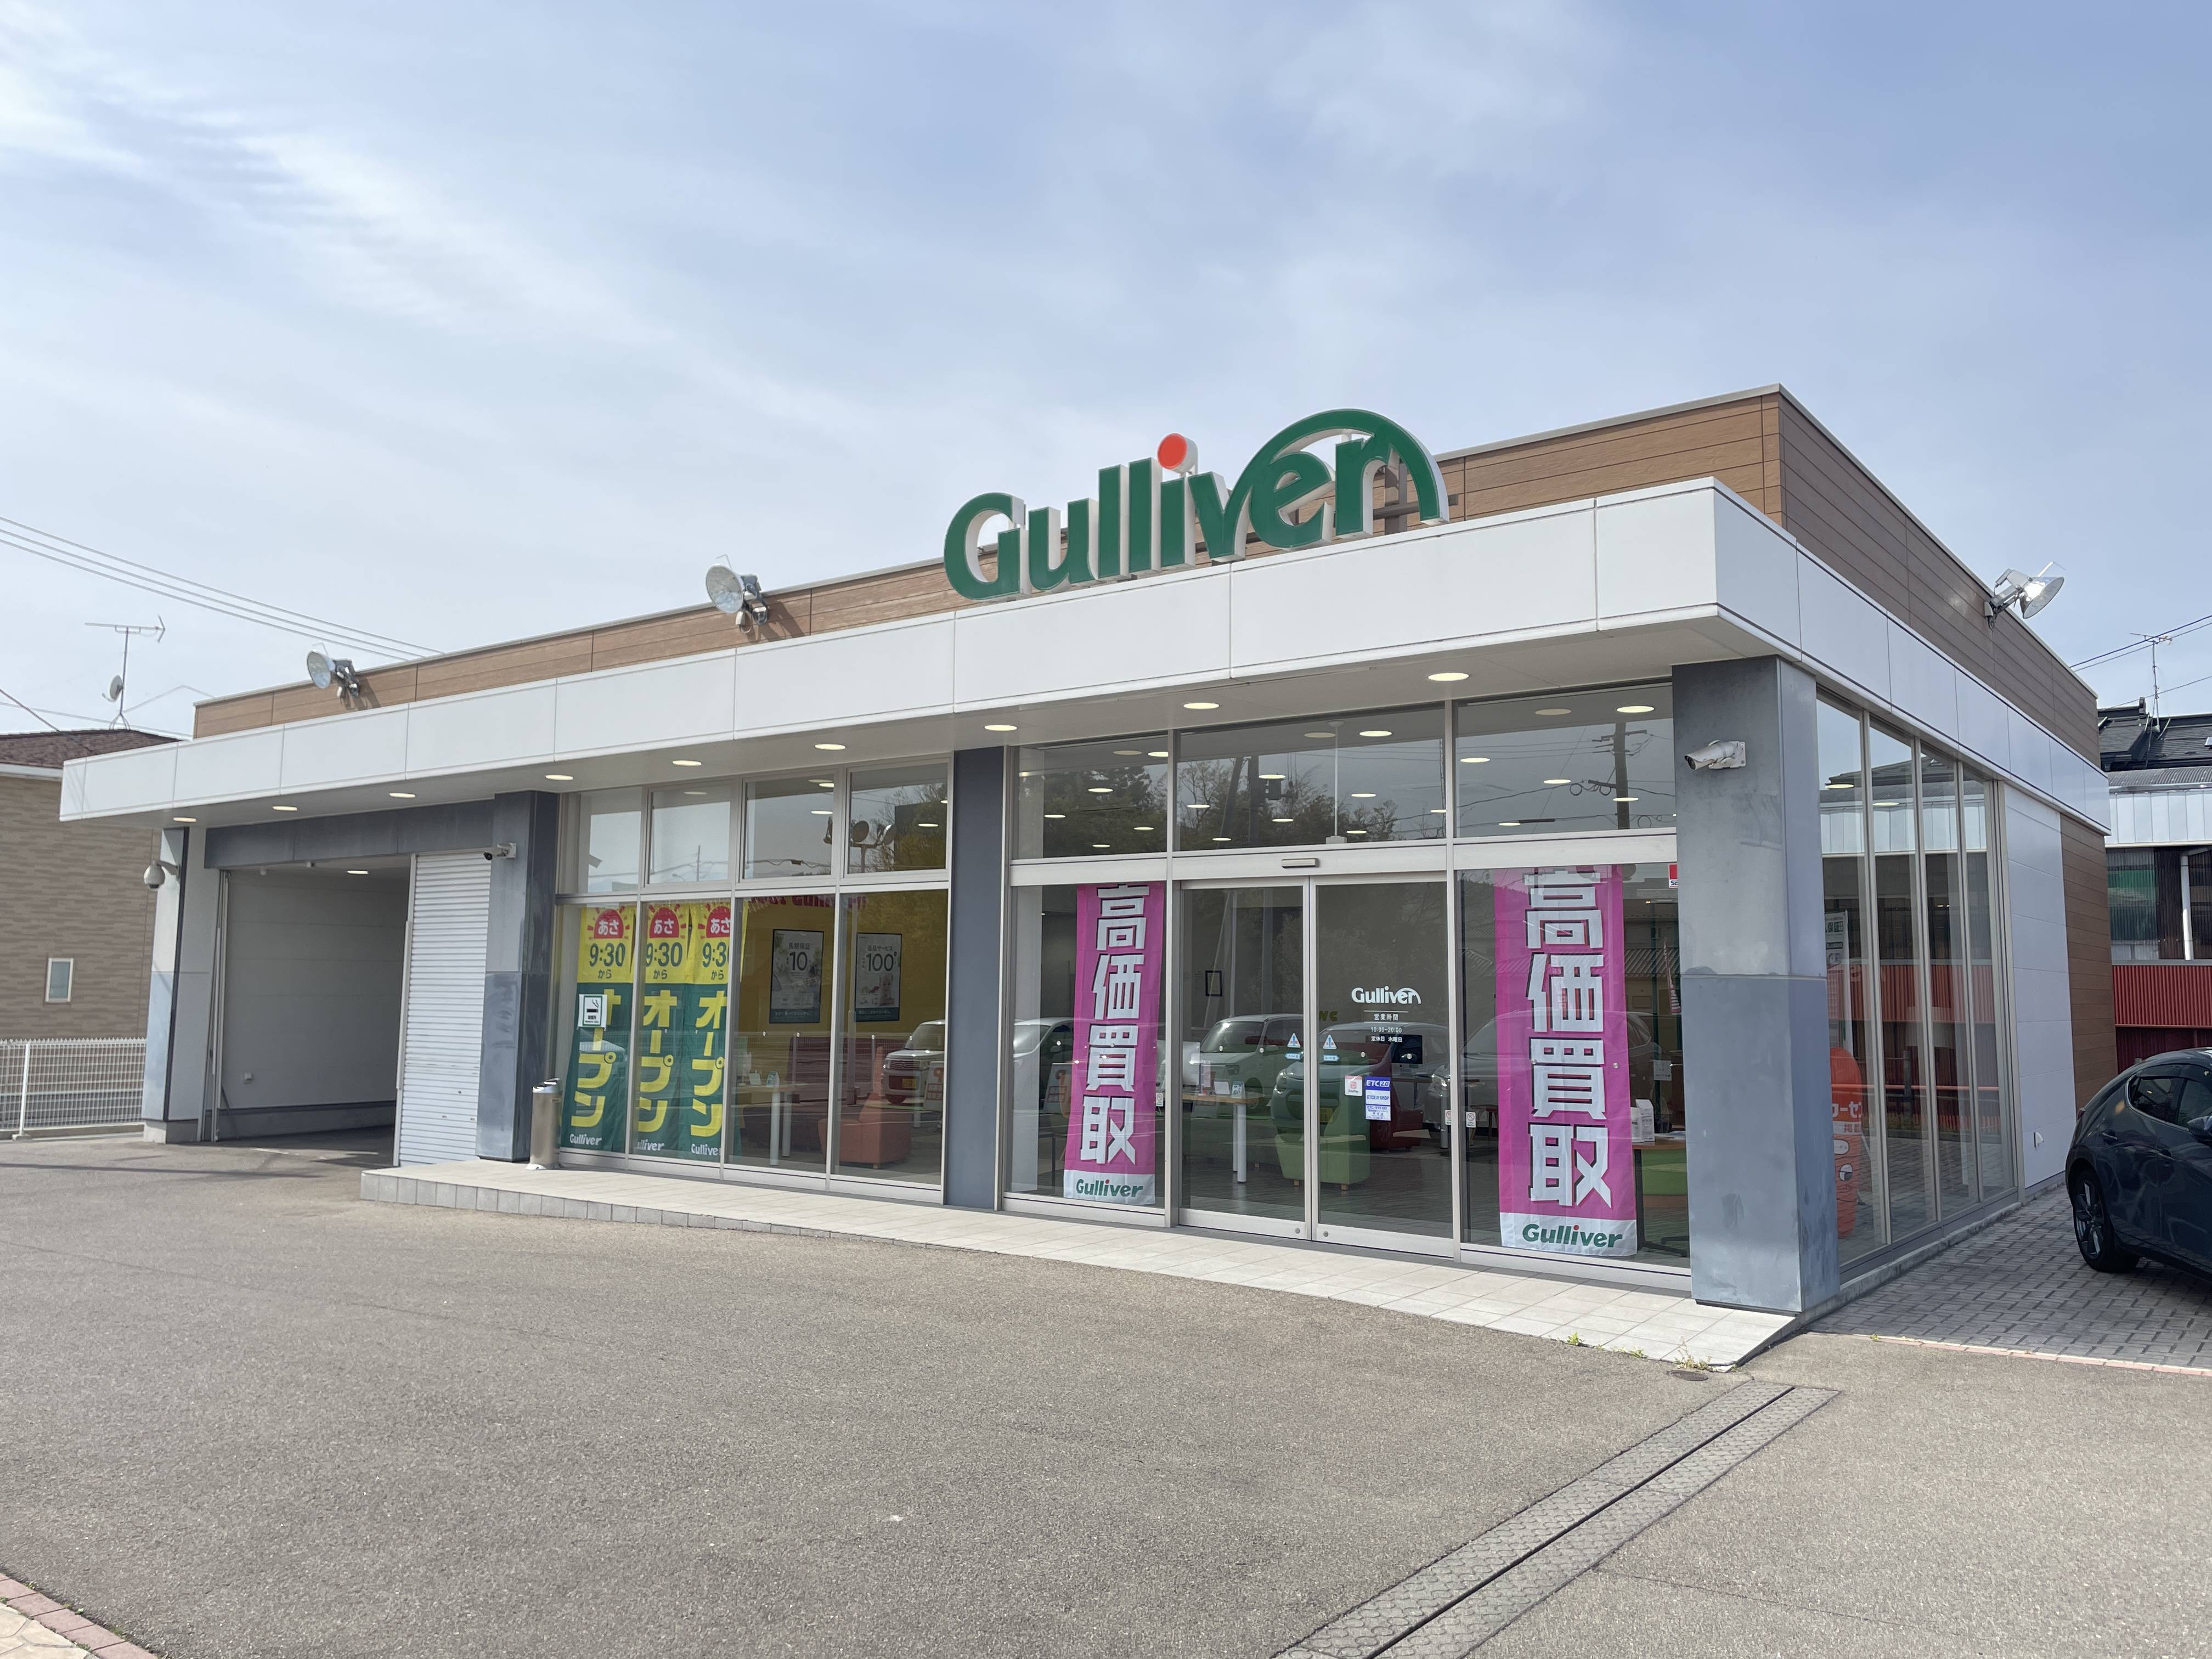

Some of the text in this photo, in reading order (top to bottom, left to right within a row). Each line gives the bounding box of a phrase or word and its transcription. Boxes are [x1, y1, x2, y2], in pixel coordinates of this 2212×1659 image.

[944, 409, 1448, 602] Gulliver
[598, 919, 619, 935] あさ
[653, 918, 675, 934] あさ
[710, 917, 731, 934] あさ
[589, 942, 626, 967] 9:30
[645, 942, 682, 967] 9:30
[702, 941, 729, 968] 9:3
[789, 951, 808, 970] 10
[866, 953, 894, 972] 100
[598, 969, 612, 979] から
[653, 969, 668, 980] から
[711, 969, 724, 980] から
[1351, 985, 1422, 1005] Gulliver
[1080, 884, 1149, 1165] 高価買取
[1524, 870, 1612, 1208] 高価買取
[637, 989, 678, 1133] オープン
[690, 990, 727, 1137] オープン
[569, 1133, 602, 1146] Gulliver
[691, 1143, 720, 1156] Gullive
[1076, 1179, 1143, 1198] Gulliver
[1522, 1223, 1623, 1249] Gulliver
